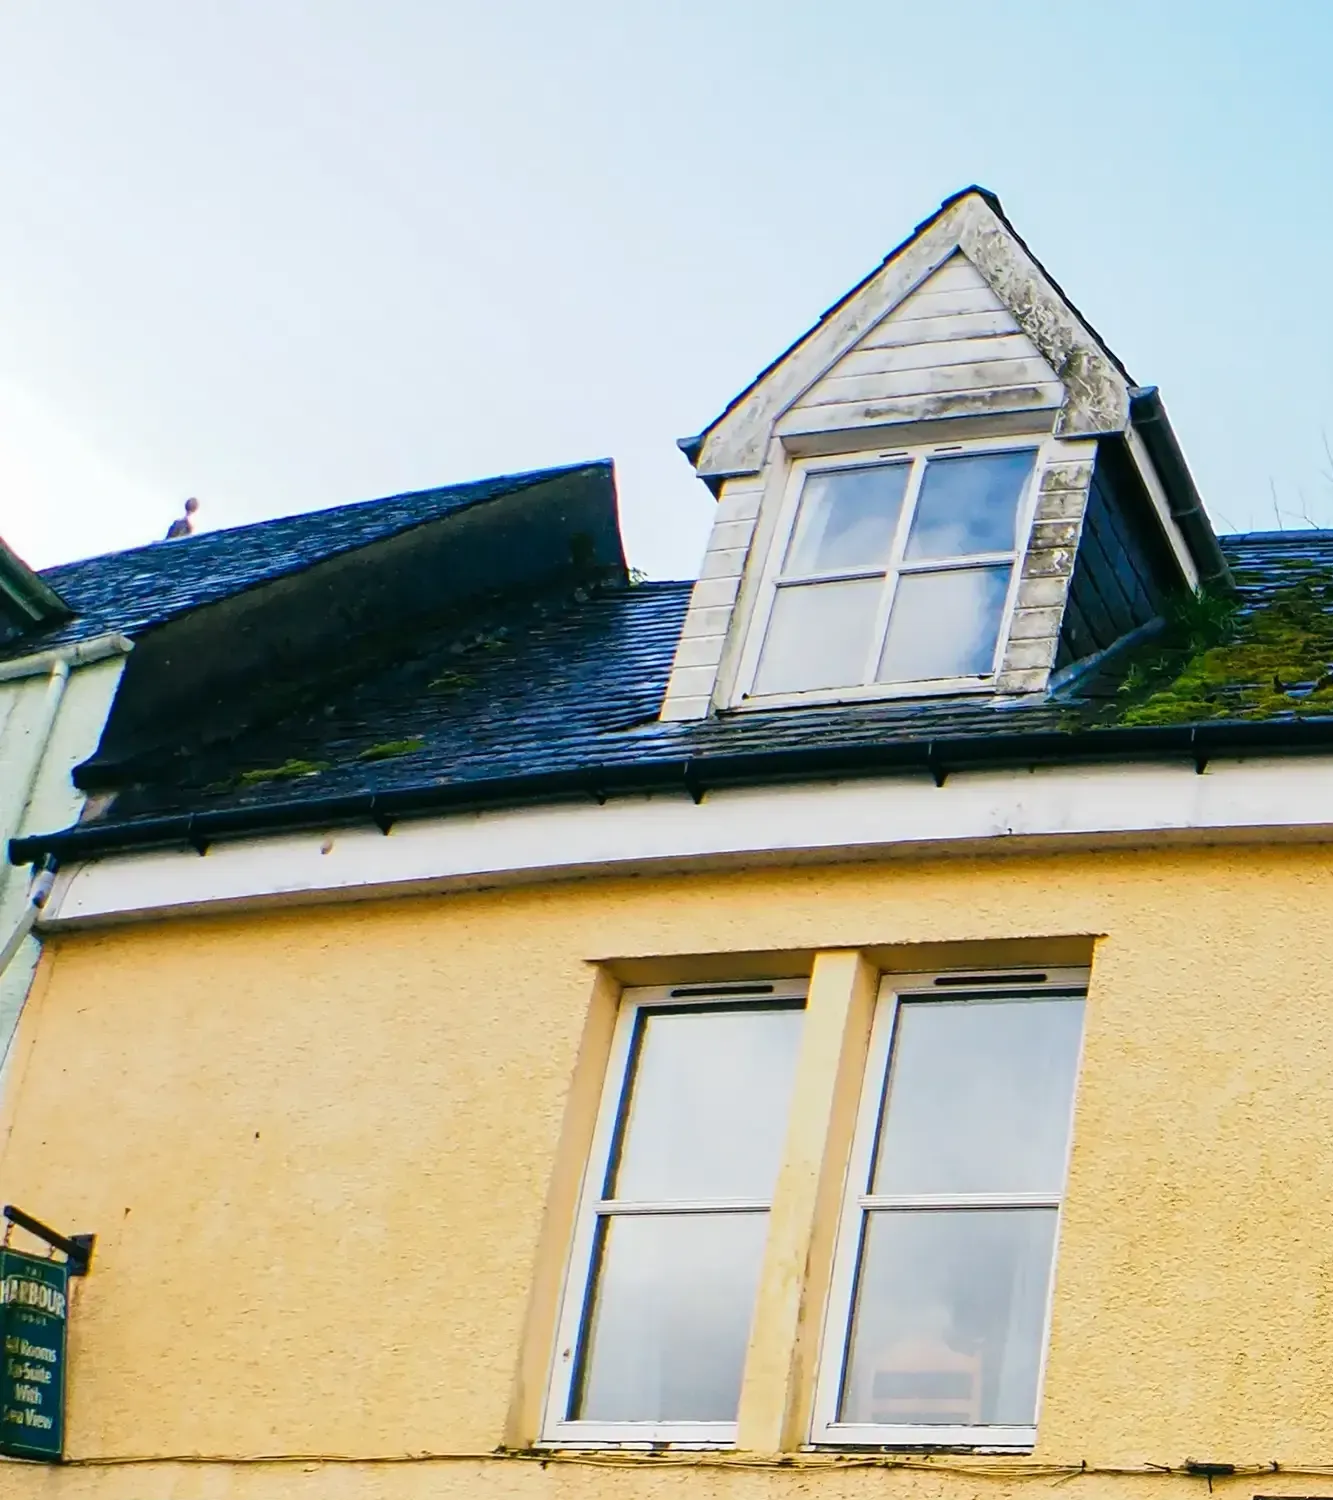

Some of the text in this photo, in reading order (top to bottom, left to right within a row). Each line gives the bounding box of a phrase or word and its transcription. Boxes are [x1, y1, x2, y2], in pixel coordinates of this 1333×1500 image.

[0, 1279, 65, 1319] HARBOUR
[20, 1338, 57, 1363] Rooms
[14, 1383, 42, 1404] With
[25, 1408, 54, 1430] View
